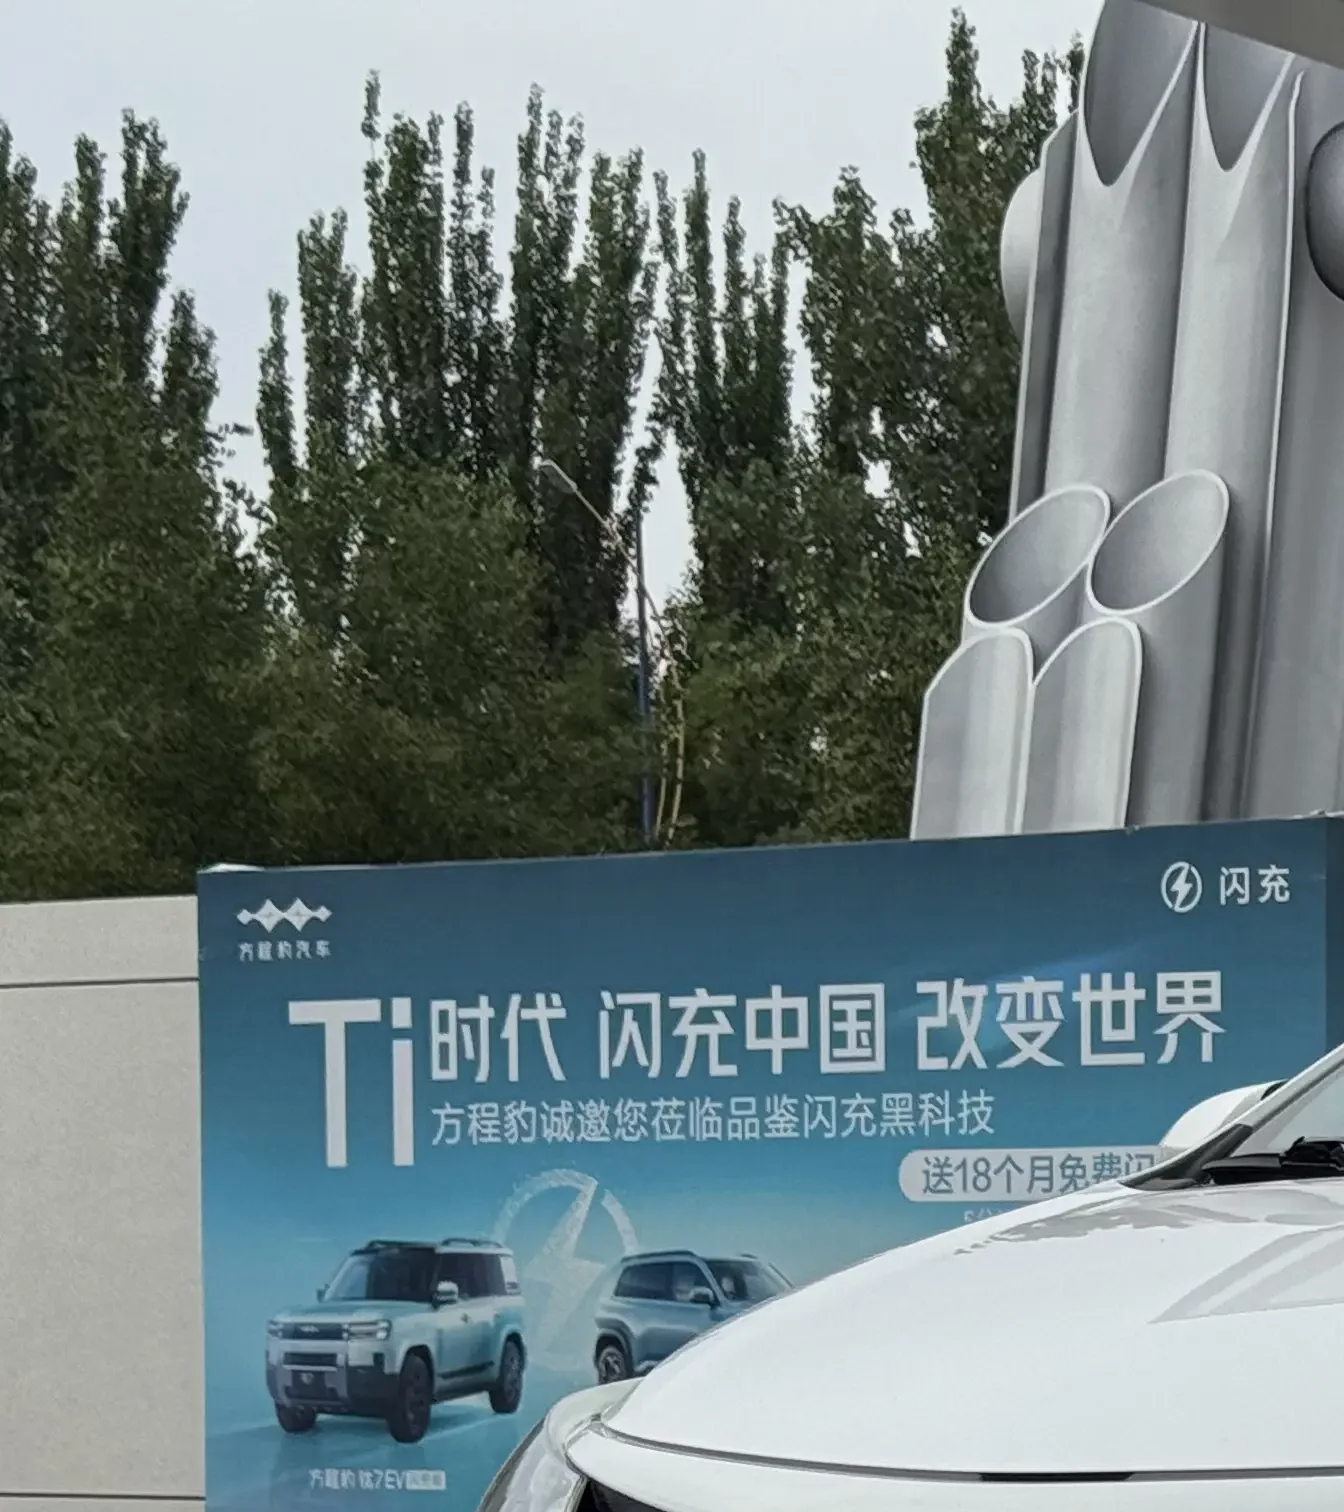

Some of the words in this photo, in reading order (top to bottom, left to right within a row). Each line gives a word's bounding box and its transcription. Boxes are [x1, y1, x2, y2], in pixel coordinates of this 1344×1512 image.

[1219, 866, 1291, 905] 闪充
[599, 984, 885, 1078] 闪充中国
[916, 971, 1225, 1070] 改变世界
[431, 1089, 995, 1146] 方程豹诚邀您莅临品鉴闪充黑科技
